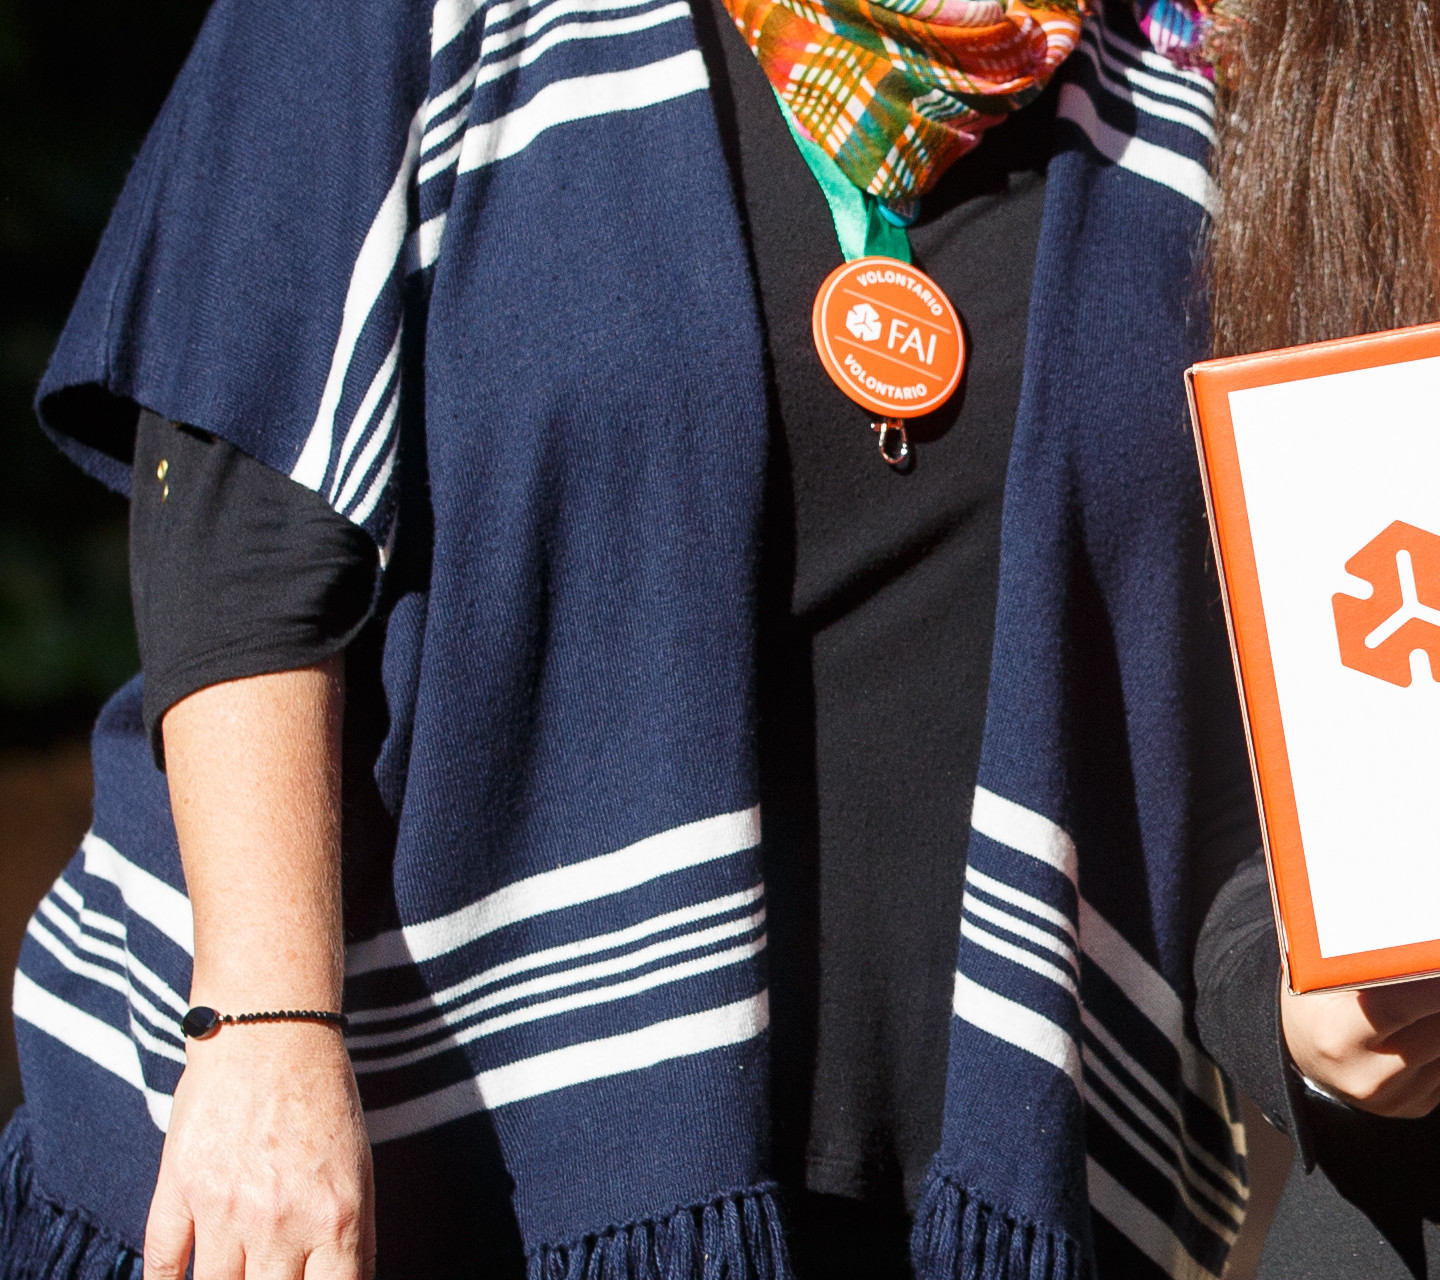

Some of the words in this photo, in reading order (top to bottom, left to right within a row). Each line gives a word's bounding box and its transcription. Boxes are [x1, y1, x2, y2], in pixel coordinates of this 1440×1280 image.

[857, 270, 944, 317] VOLONTARIO
[888, 318, 937, 365] FAI
[844, 354, 927, 400] VOLONTARIO
